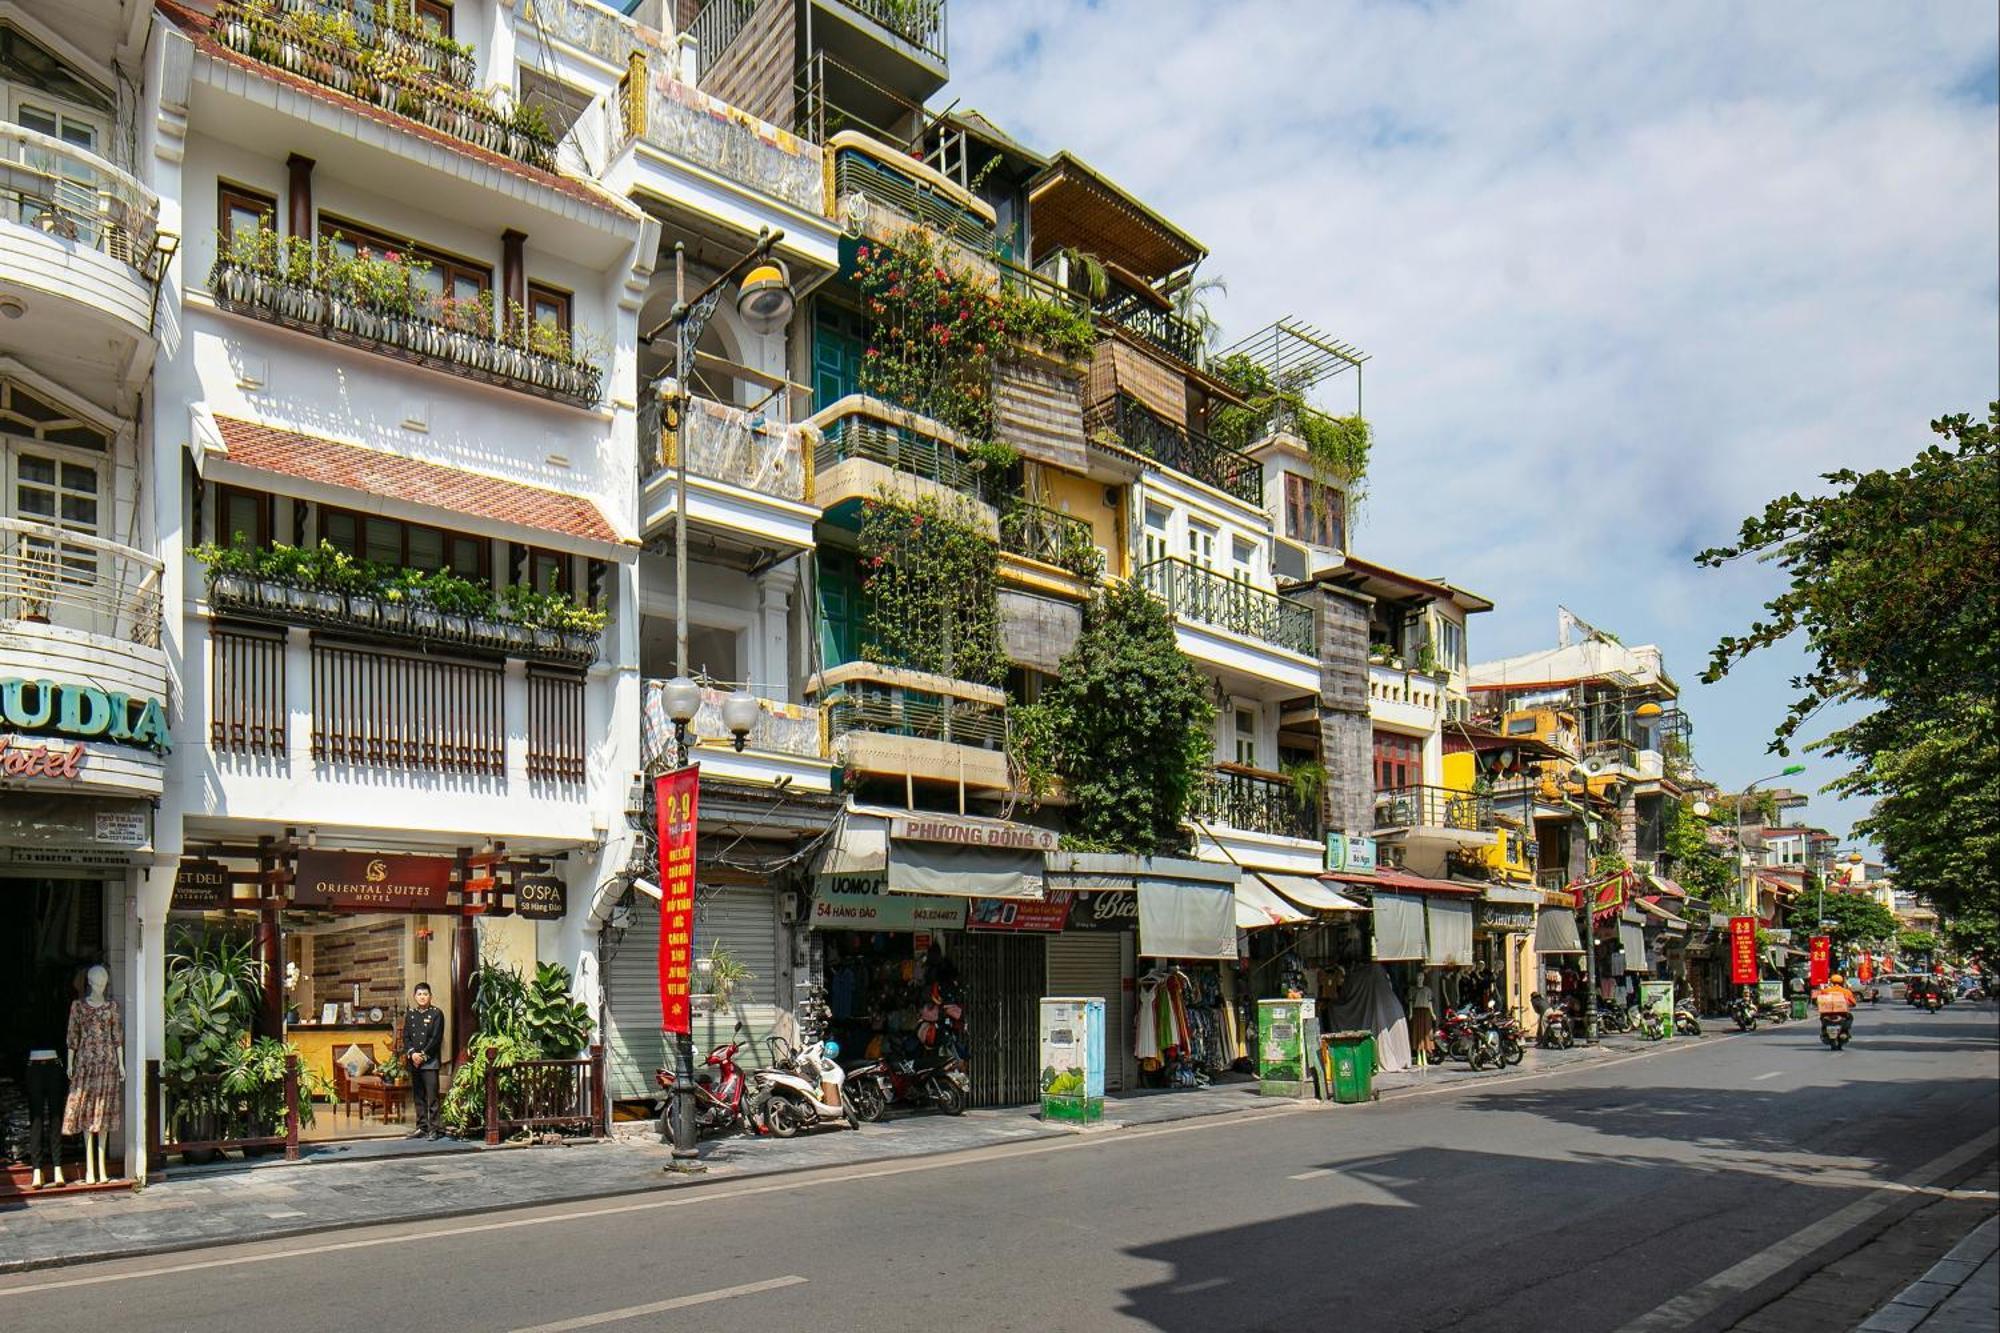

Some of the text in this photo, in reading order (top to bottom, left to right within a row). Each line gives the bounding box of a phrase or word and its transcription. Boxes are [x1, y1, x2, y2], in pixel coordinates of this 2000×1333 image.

[0, 677, 174, 753] UDIA
[906, 821, 982, 843] PHƯƠNG
[987, 826, 1034, 847] ĐÔNG
[196, 873, 222, 885] DELI
[831, 877, 871, 895] UOMO
[316, 881, 431, 896] ORIENTAL SUITES
[522, 884, 561, 901] O'SPA
[355, 894, 391, 903] HOTEL
[817, 903, 831, 917] 54
[832, 906, 856, 918] HÀNG
[859, 907, 877, 919] ĐÀO
